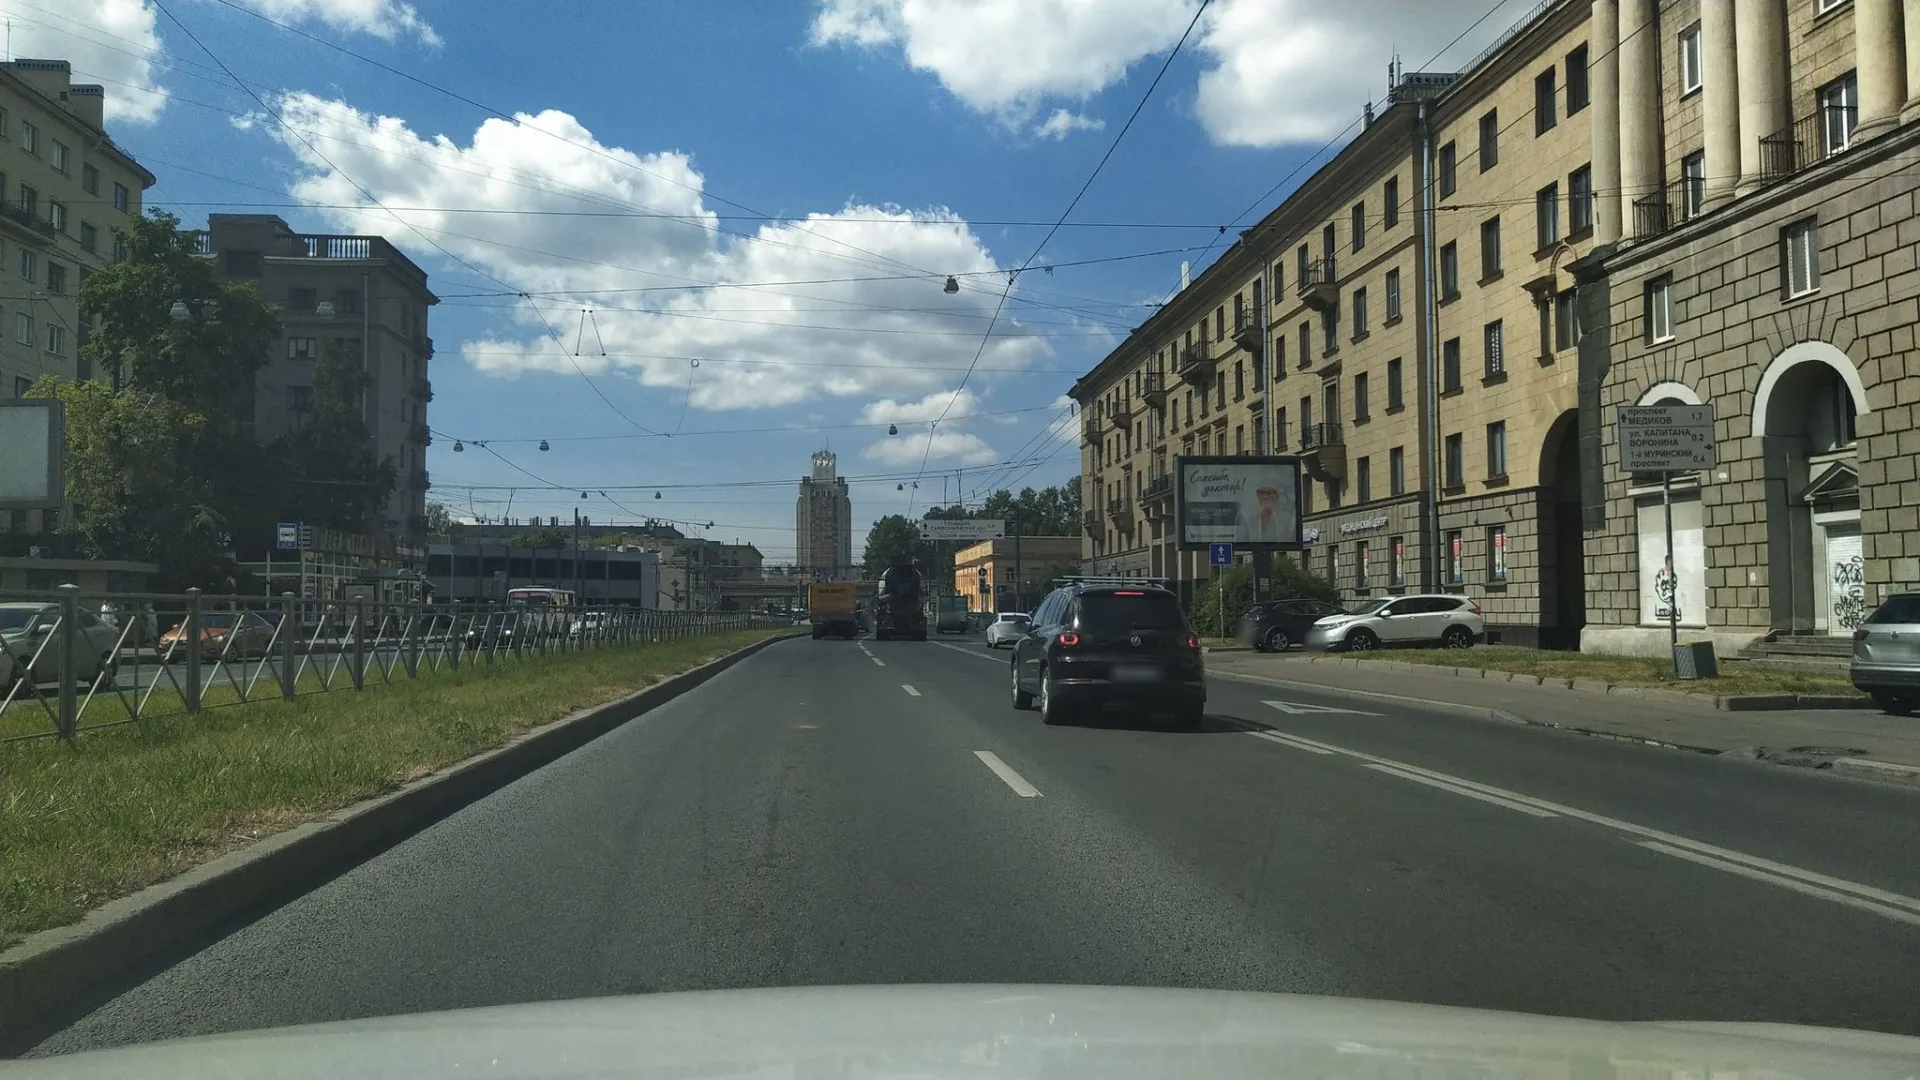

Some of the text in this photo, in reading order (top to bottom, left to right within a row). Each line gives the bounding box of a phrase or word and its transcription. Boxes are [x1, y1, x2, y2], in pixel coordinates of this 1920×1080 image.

[1628, 408, 1667, 416] проспект
[1692, 412, 1703, 420] 1,7
[1628, 416, 1672, 425] МЕДИКОВ
[1644, 428, 1690, 436] КАПИТАНА
[1629, 439, 1679, 447] ВОРОНИНА
[1644, 449, 1692, 458] МУРИНСКИЙ
[1630, 460, 1670, 468] проспект
[1201, 478, 1246, 498] доктор!
